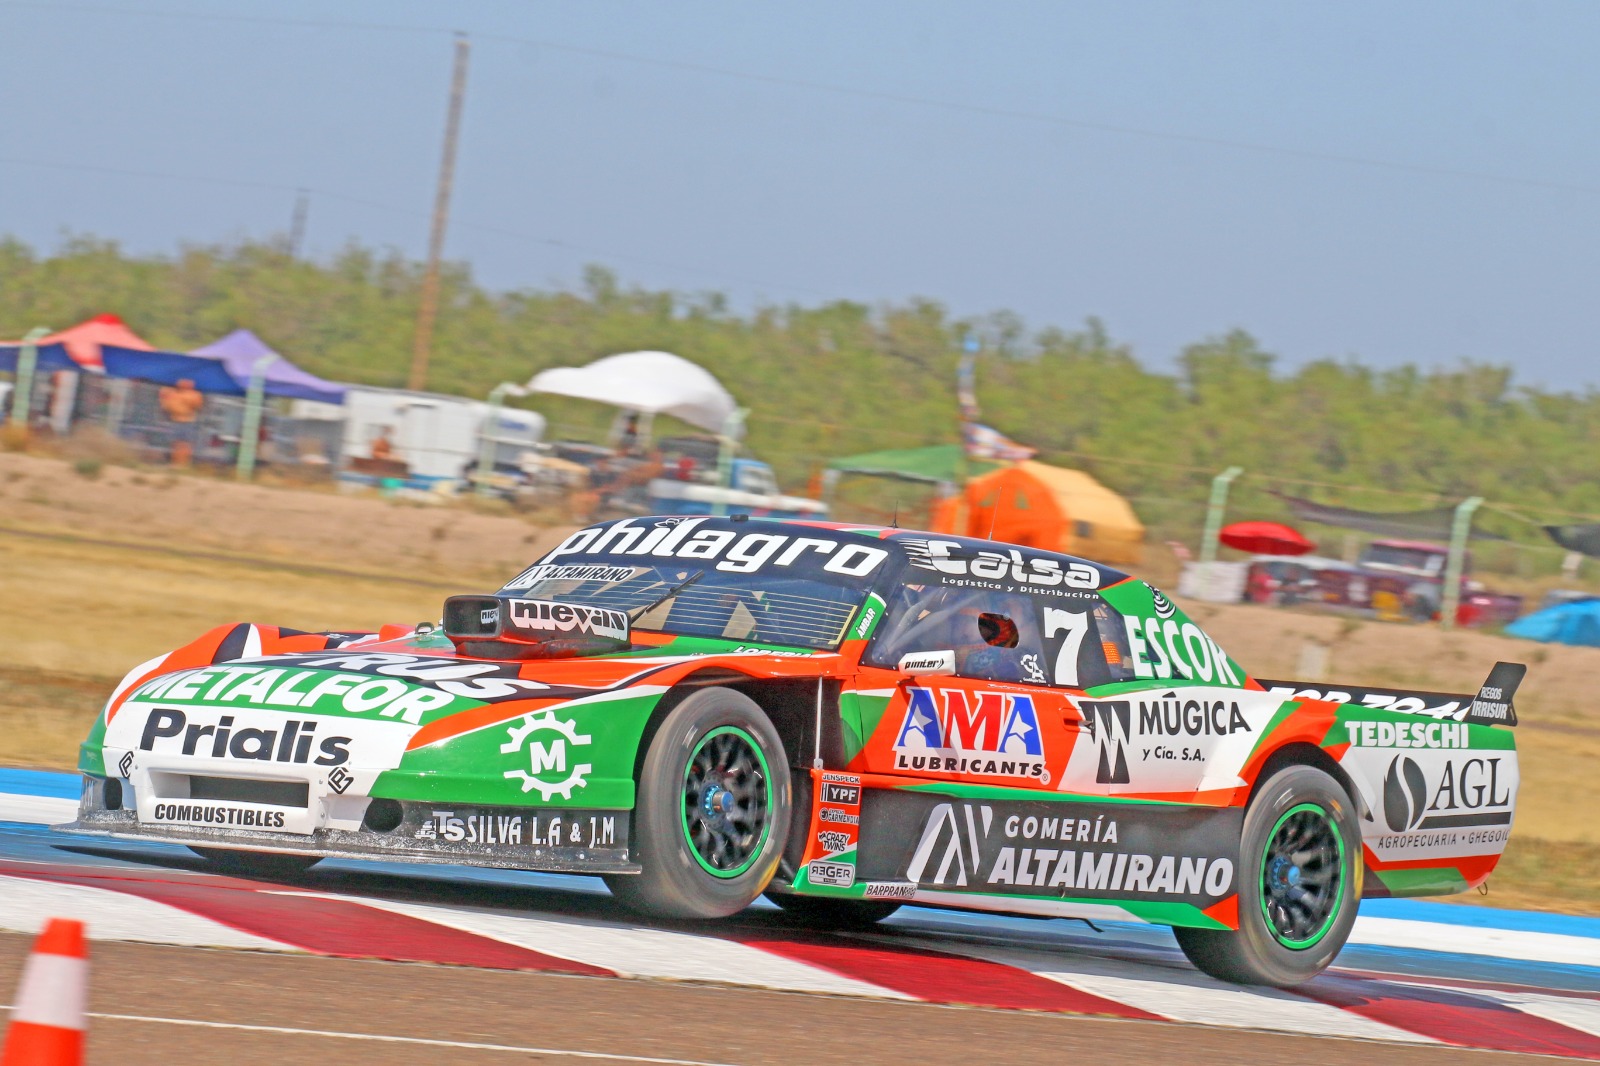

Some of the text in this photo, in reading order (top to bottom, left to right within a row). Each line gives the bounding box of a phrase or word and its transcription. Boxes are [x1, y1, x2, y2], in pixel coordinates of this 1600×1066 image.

[539, 518, 889, 576] philagro
[543, 567, 633, 582] ALTAMIRANO
[1007, 585, 1014, 593] y
[1044, 607, 1088, 686] 7
[130, 664, 455, 725] METALFOR
[896, 688, 1042, 756] AMA
[1139, 691, 1252, 736] MÚGICA
[1471, 700, 1508, 720] IRRISUR
[139, 708, 353, 766] Prialis
[1345, 721, 1469, 748] TEDESCHI
[898, 755, 1043, 776] LUBRICANTS
[1142, 745, 1205, 762] y Cía. S.A.
[831, 787, 857, 801] YPF
[1426, 758, 1510, 810] AGL
[154, 804, 285, 828] COMBUSTIBLES
[1004, 815, 1118, 843] GOMERÍA
[466, 815, 521, 845] SILVA
[569, 822, 581, 843] &
[825, 832, 850, 843] CRAZY
[1378, 833, 1457, 849] AGROPECUARIA
[823, 841, 846, 852] TWINS
[987, 847, 1234, 897] ALTAMIRANO
